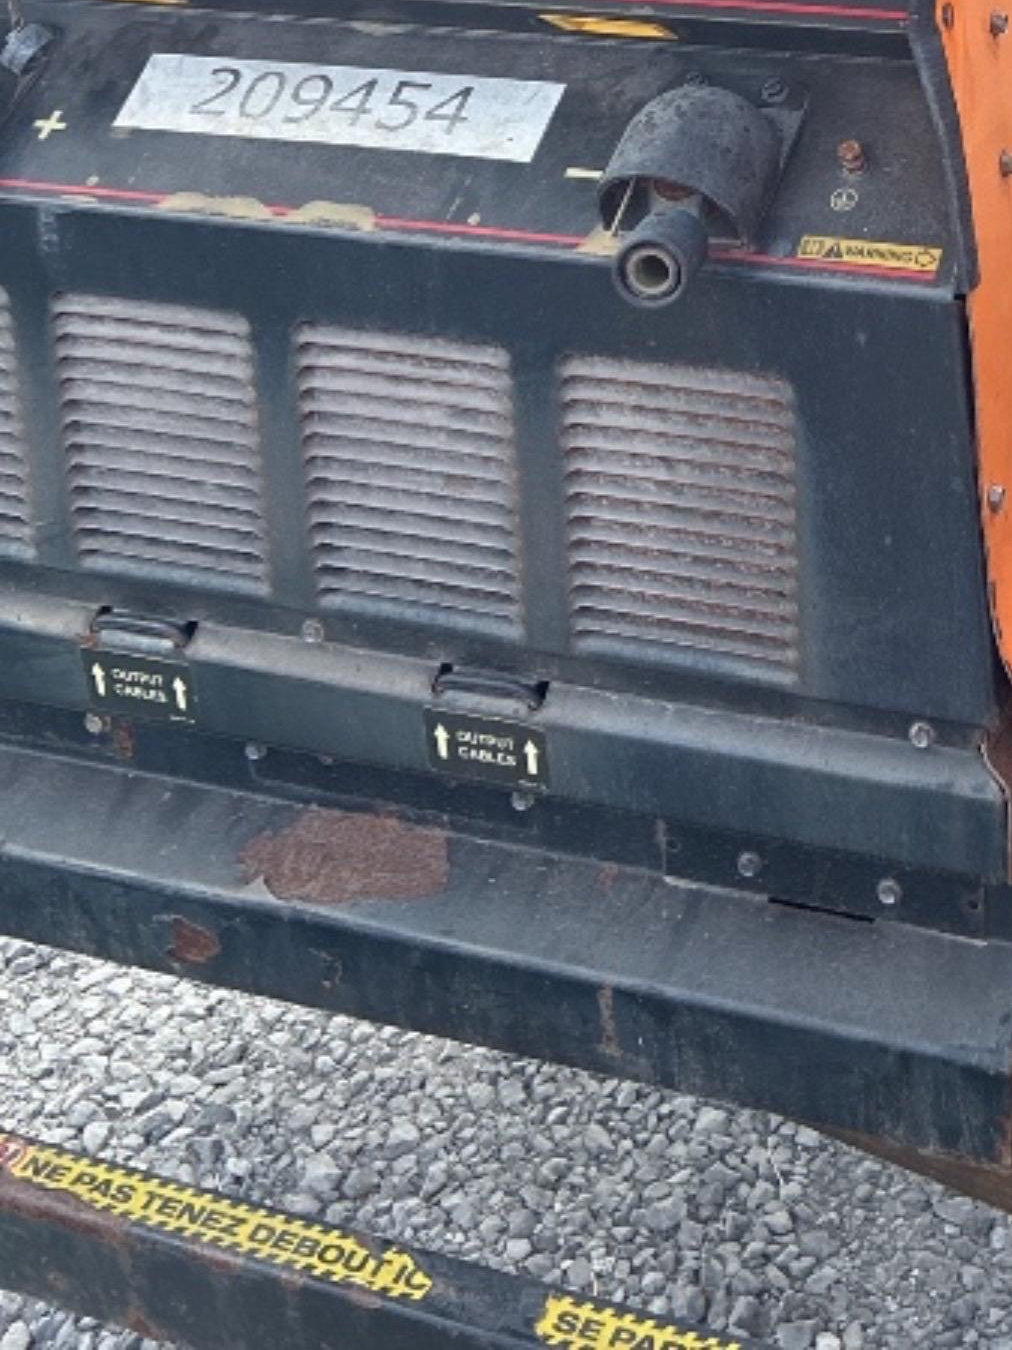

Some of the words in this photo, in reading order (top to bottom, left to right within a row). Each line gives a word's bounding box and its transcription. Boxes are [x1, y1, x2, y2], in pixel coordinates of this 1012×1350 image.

[189, 66, 475, 136] 209454
[22, 1156, 67, 1182] NE
[69, 1170, 136, 1205] PAS
[141, 1190, 250, 1238] TENEZ
[248, 1222, 394, 1280] DEBOUT
[551, 1310, 606, 1340] SE
